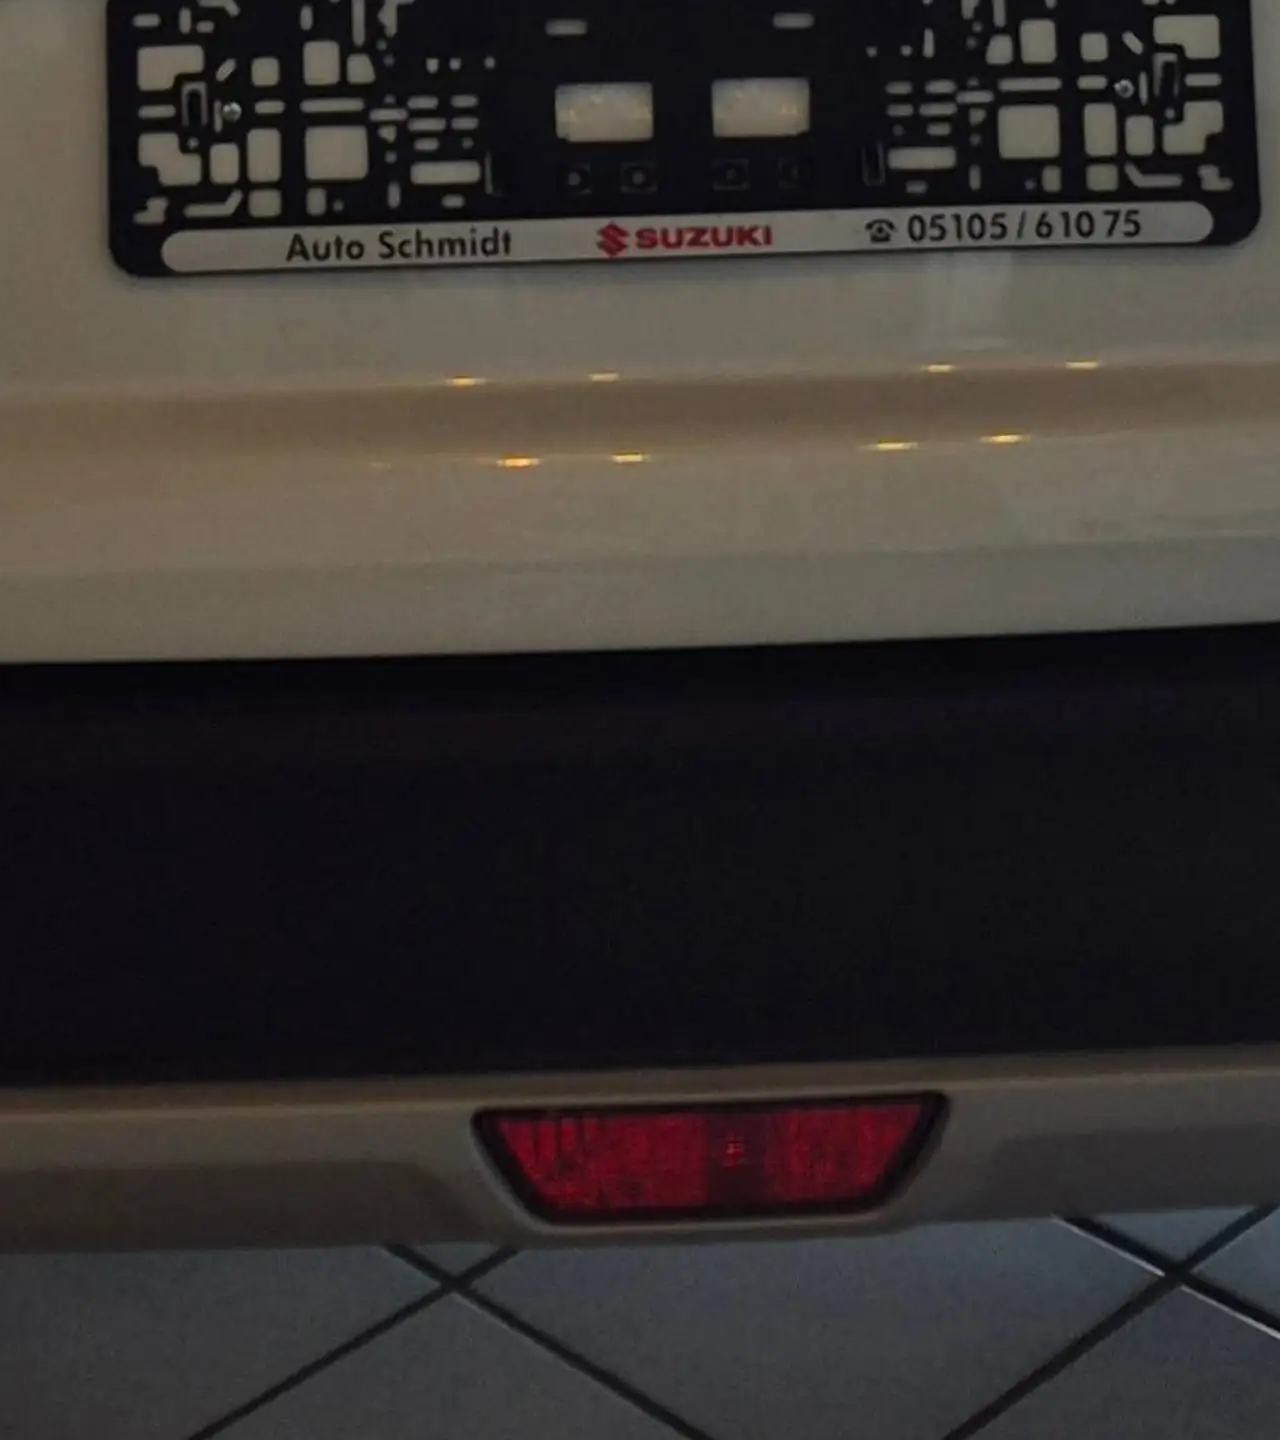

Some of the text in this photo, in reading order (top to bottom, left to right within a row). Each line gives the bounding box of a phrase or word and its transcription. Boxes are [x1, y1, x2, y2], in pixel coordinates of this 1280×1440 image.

[286, 233, 365, 261] Auto
[378, 227, 513, 258] Schmidt
[635, 224, 773, 249] SUZUKI
